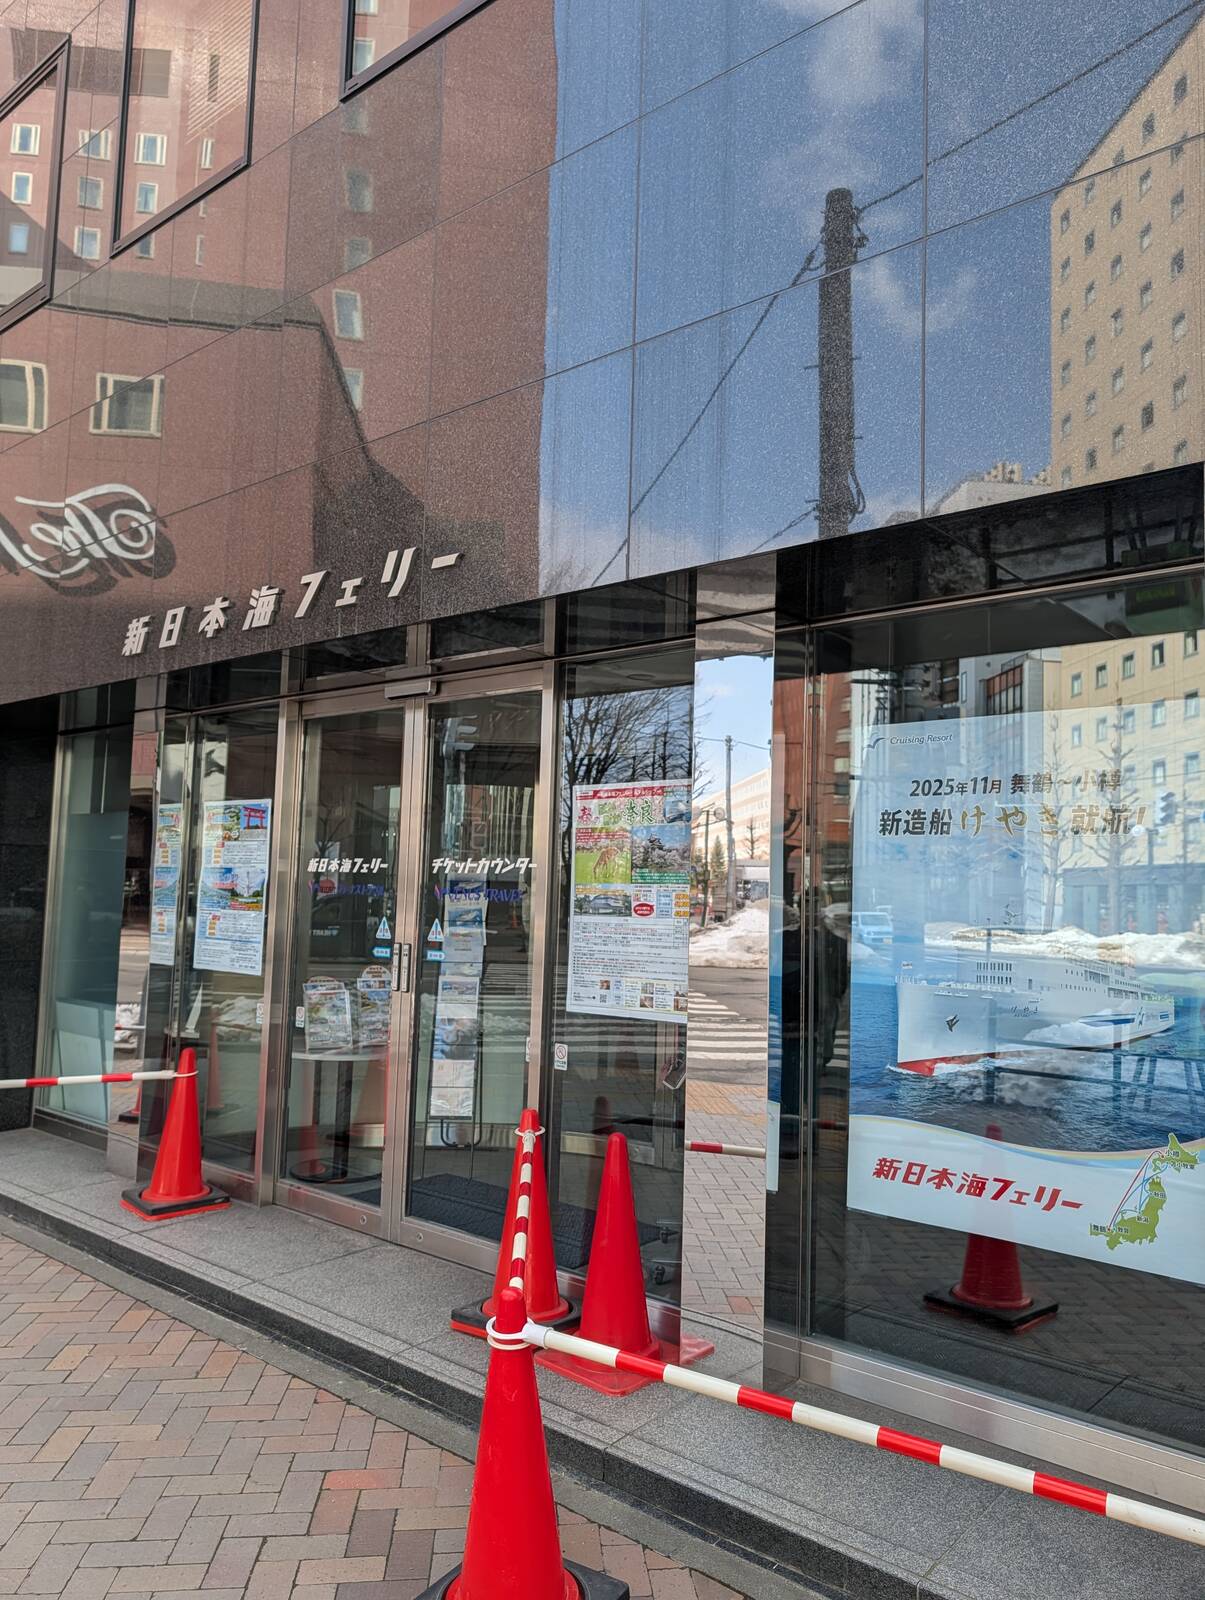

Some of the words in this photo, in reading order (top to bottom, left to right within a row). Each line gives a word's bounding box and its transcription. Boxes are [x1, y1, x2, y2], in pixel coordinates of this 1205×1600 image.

[121, 547, 464, 656] 新日本海フェリー
[890, 736, 926, 746] Cruising
[927, 734, 953, 743] Resort
[909, 776, 1002, 797] 2025年11月
[306, 857, 389, 874] 新日本海フェリー
[431, 857, 538, 875] チケットカウンター
[871, 1156, 1084, 1212] 新日本海フェリー
